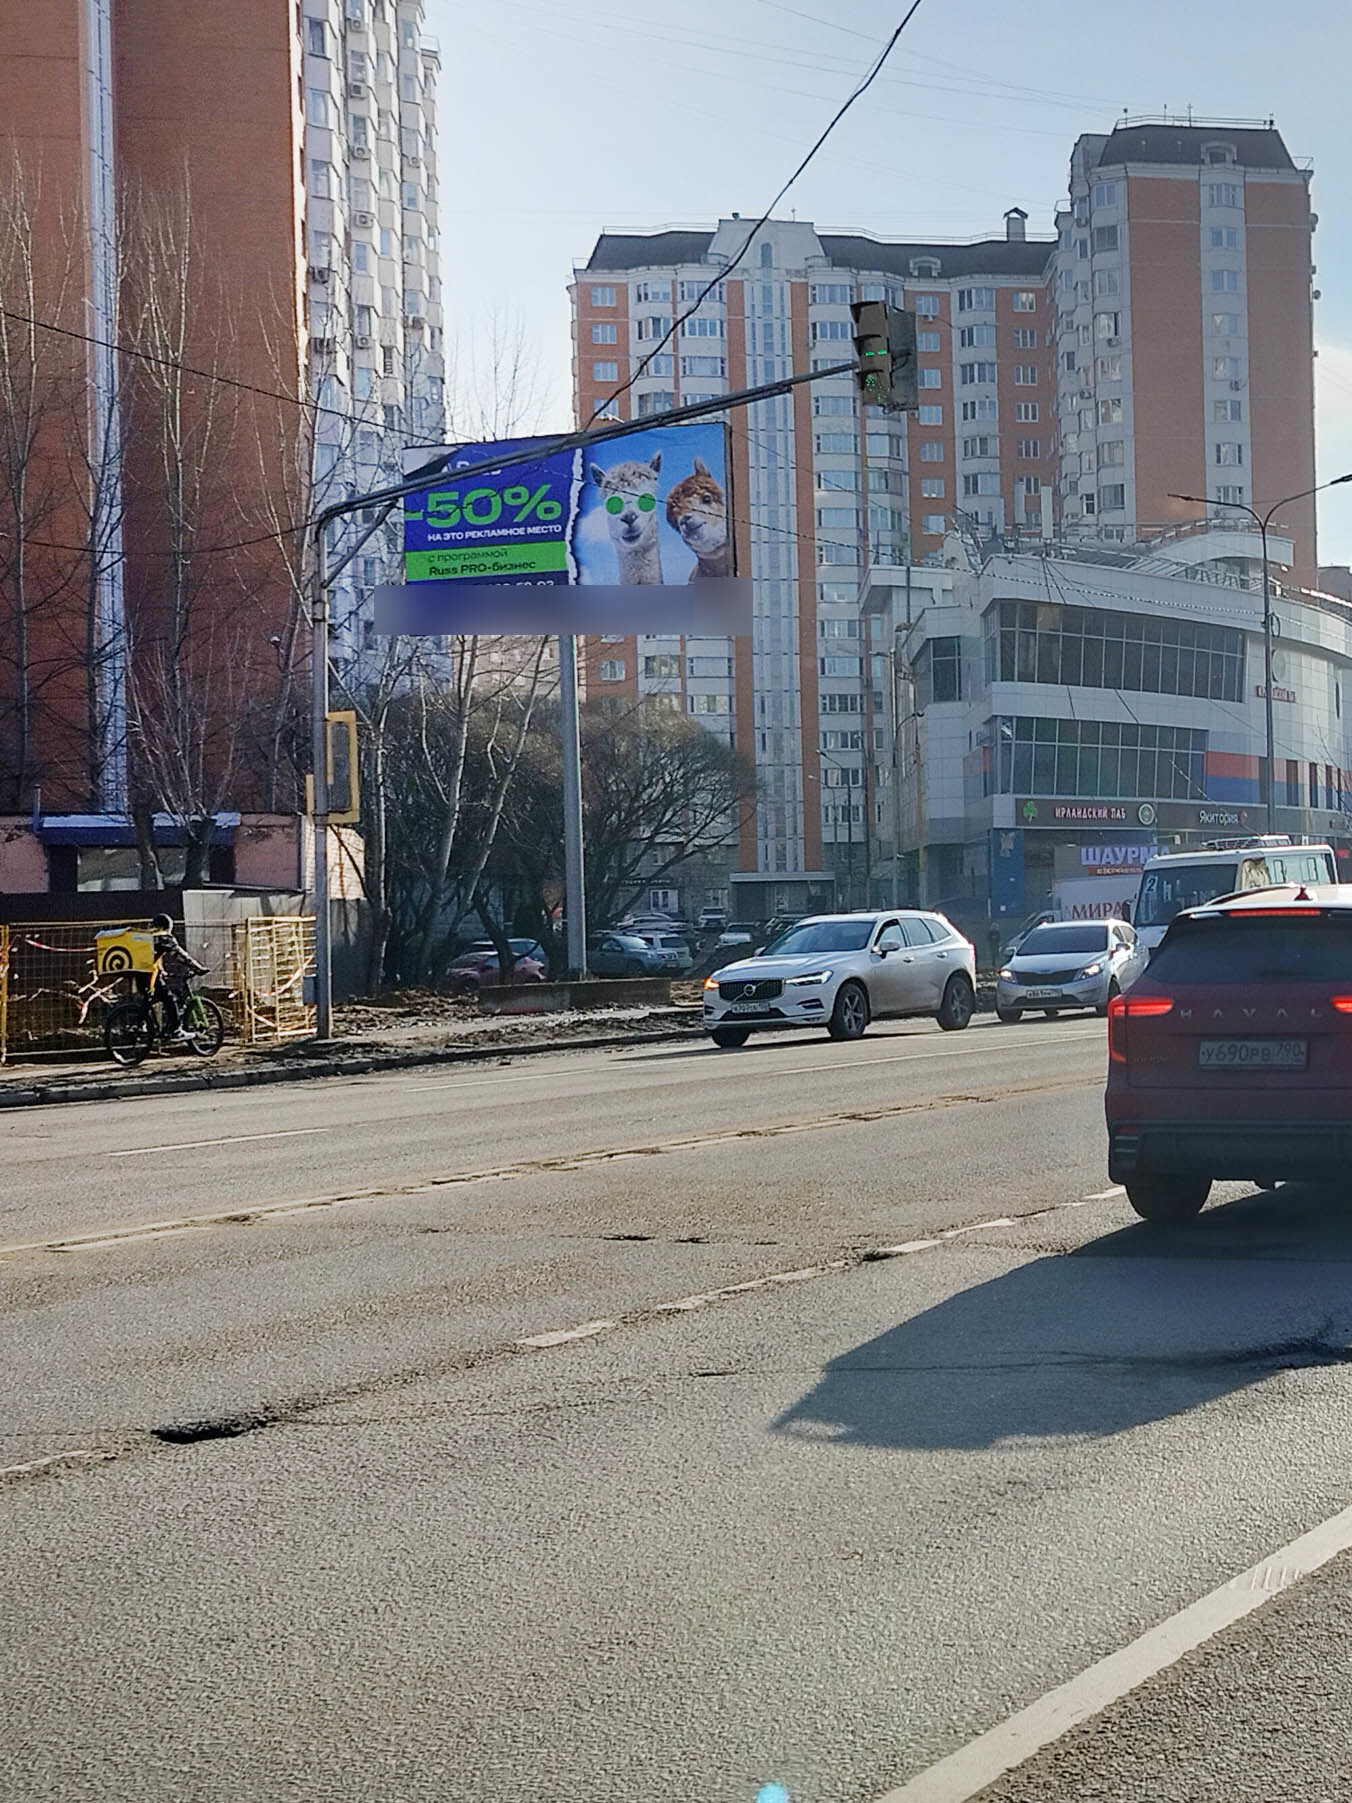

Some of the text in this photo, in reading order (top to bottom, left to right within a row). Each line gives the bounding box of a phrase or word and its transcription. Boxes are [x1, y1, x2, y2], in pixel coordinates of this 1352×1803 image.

[404, 484, 562, 528] -50%
[428, 525, 562, 541] НА ЭТО РЕКЛАМНОЕ МЕСТО
[429, 561, 537, 576] Russ PRO-бизнес
[1055, 806, 1126, 819] ИРЛАНДСКИЙ ПАБ
[1180, 1008, 1322, 1017] HAVAL
